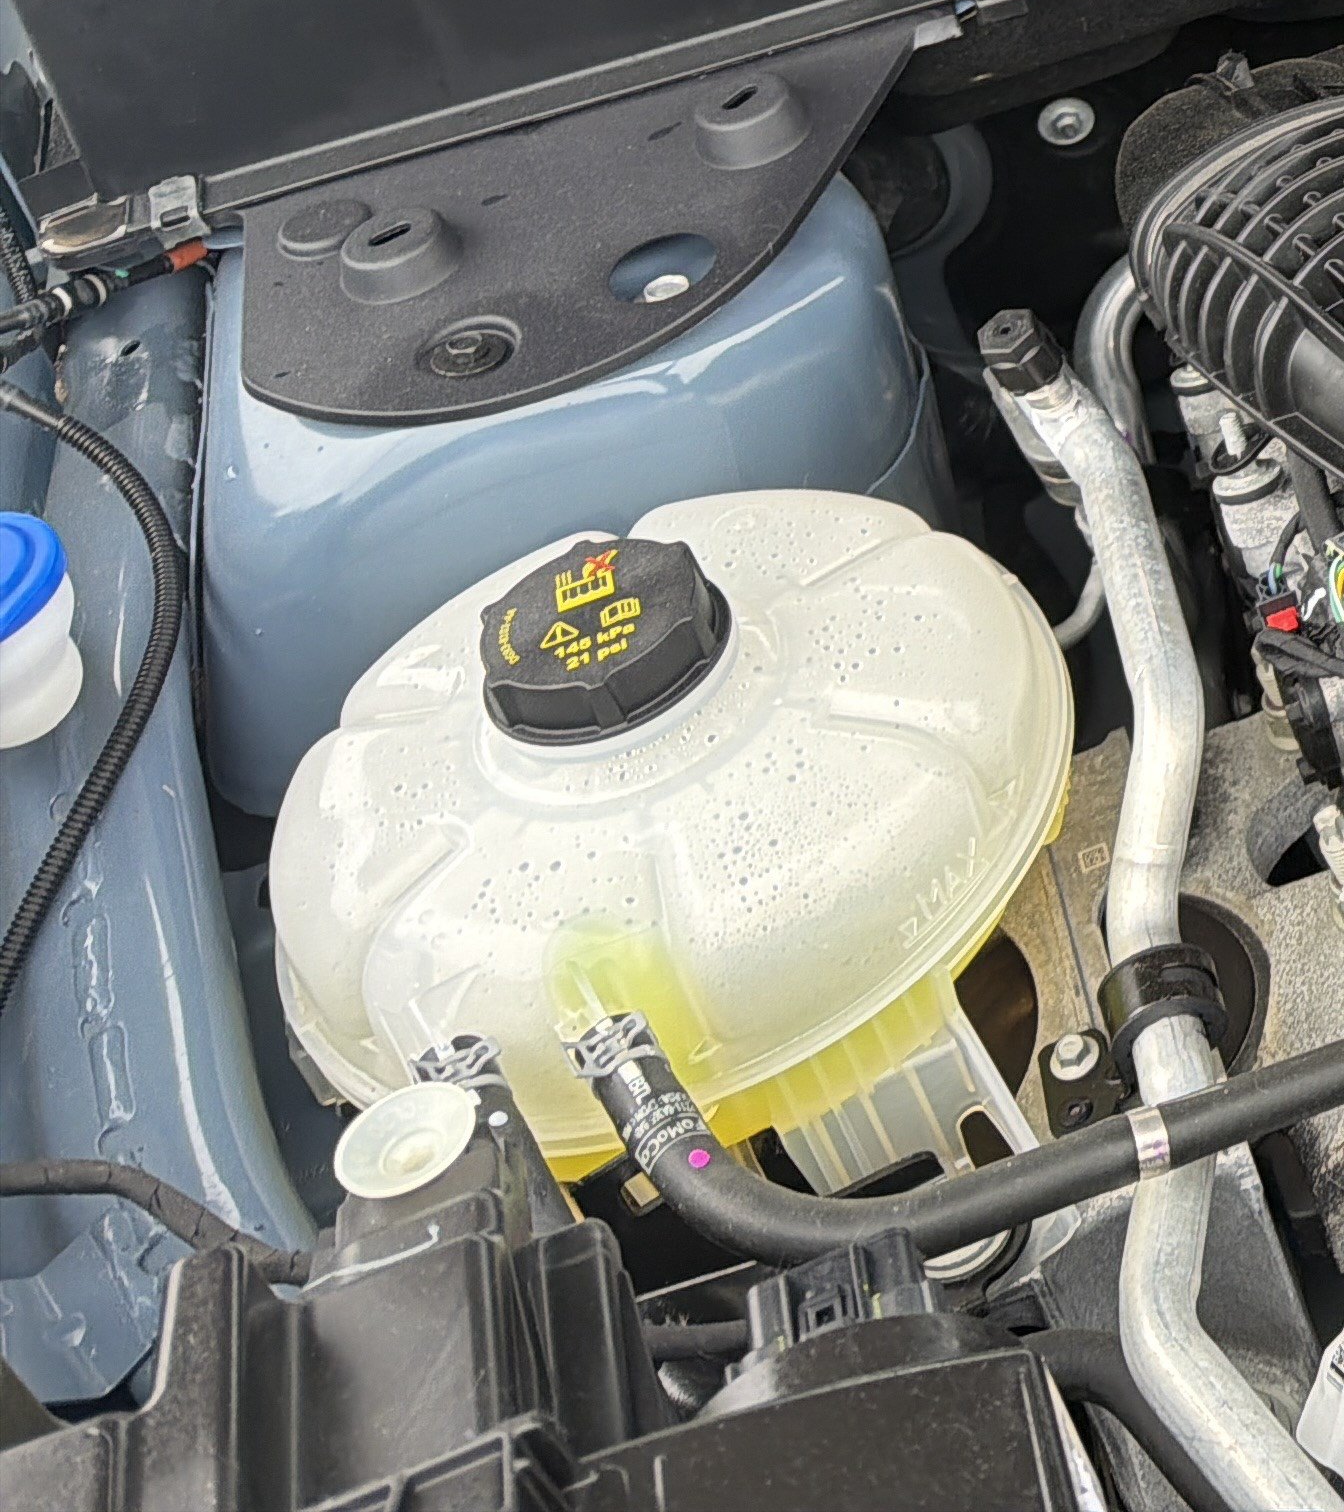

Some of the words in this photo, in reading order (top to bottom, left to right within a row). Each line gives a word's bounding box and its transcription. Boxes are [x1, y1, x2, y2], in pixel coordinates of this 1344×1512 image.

[597, 623, 635, 644] kPa
[566, 651, 590, 671] 21
[597, 637, 628, 662] psi
